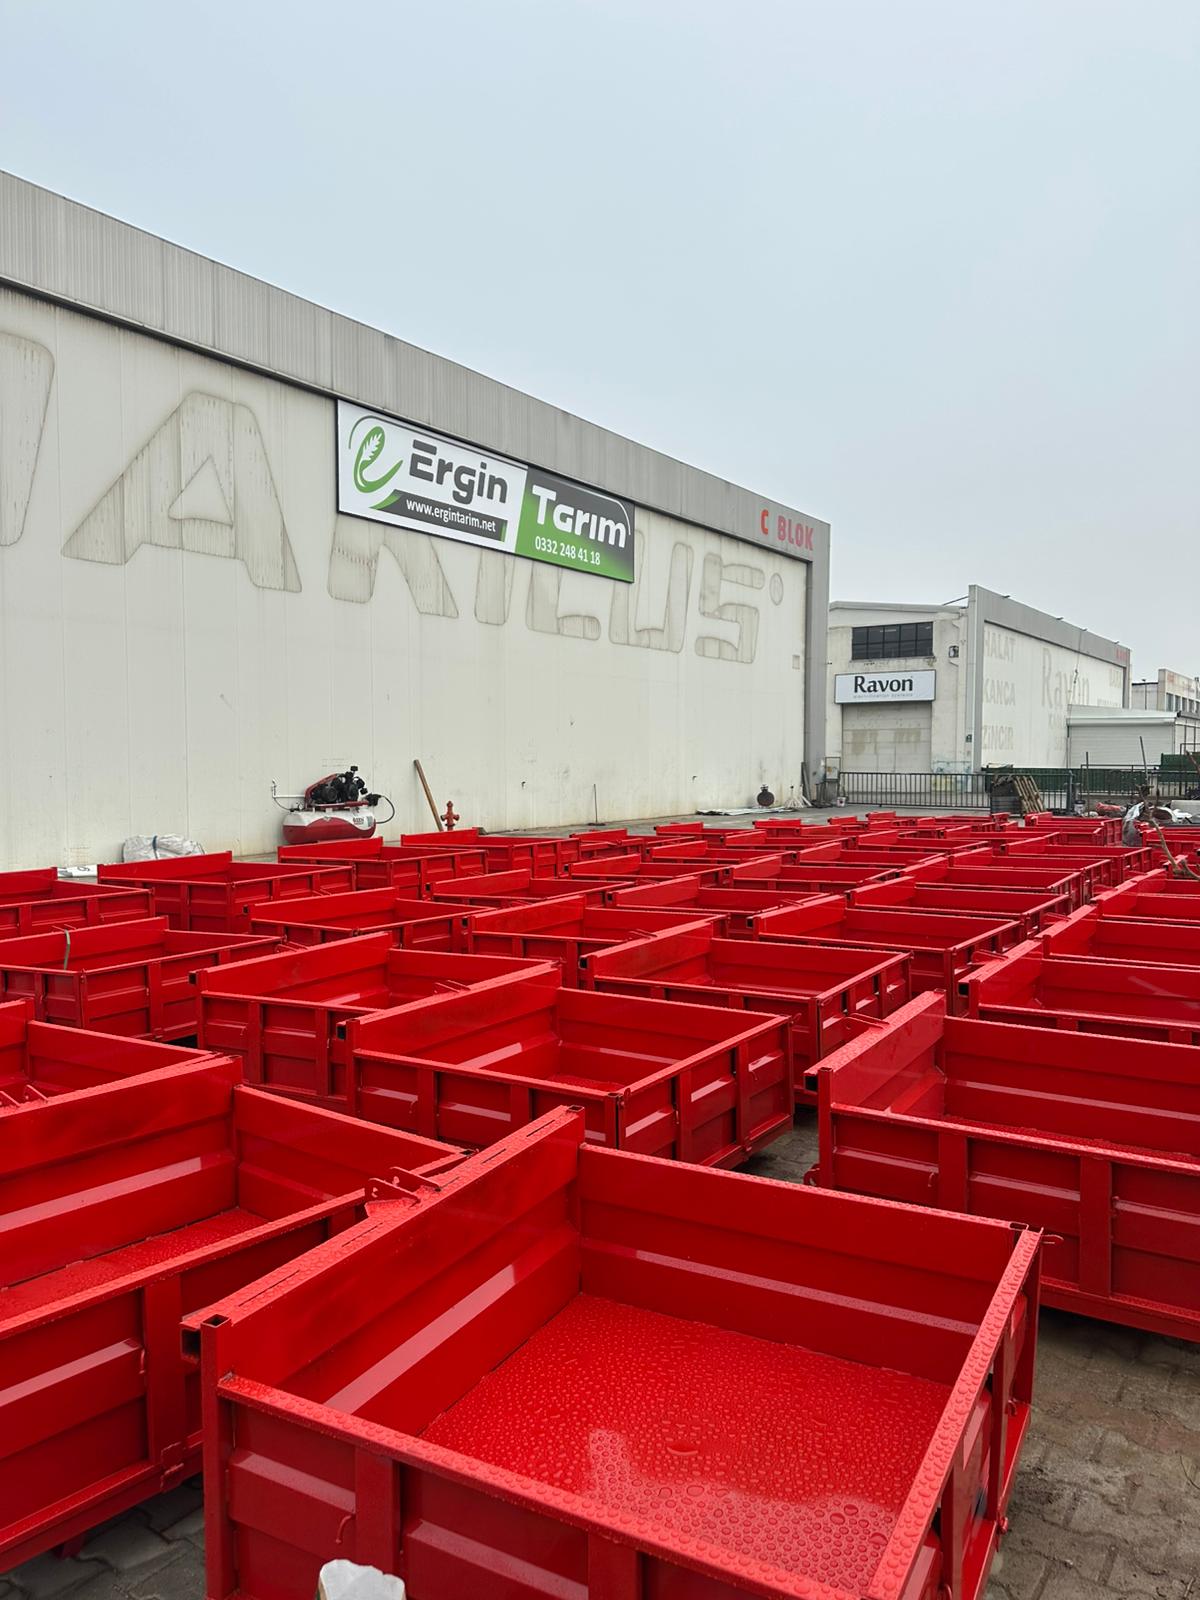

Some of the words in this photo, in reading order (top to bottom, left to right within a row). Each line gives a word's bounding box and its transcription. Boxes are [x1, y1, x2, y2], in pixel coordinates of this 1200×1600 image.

[409, 439, 508, 504] Ergin
[406, 499, 496, 532] www.ergintarim.net
[760, 508, 769, 536] C
[777, 515, 814, 551] BLOK
[535, 536, 558, 554] 0332
[560, 542, 576, 560] 248
[577, 547, 588, 562] 41
[590, 551, 601, 566] 18
[854, 675, 913, 693] Ravon
